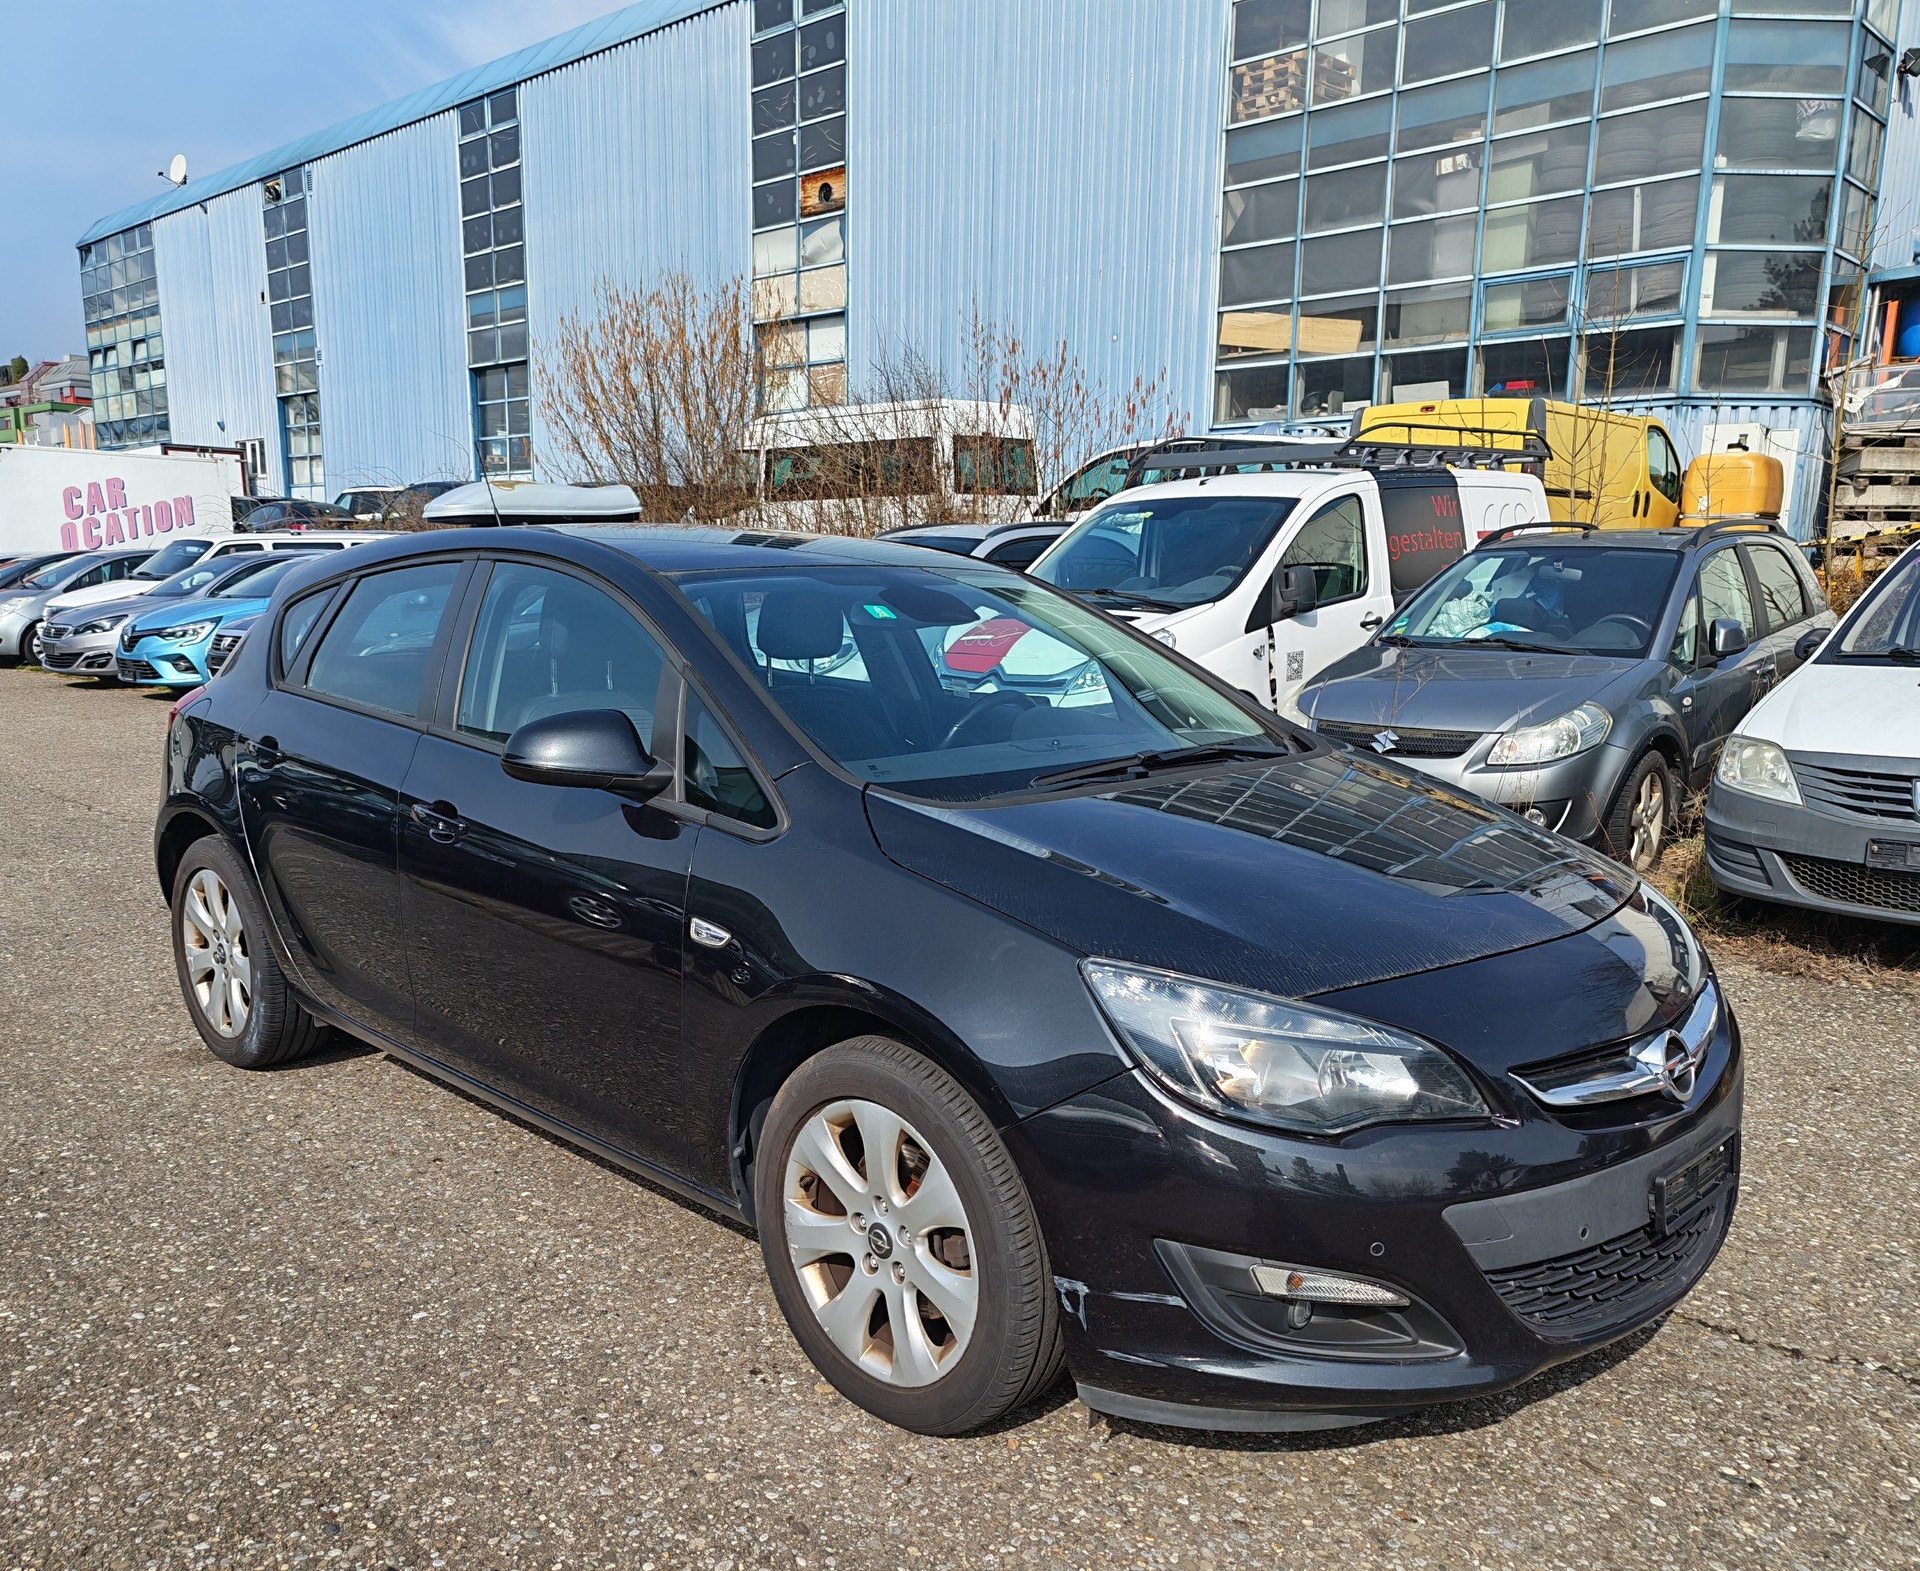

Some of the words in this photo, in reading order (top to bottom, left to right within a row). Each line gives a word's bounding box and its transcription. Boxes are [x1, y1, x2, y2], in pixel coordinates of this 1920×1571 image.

[62, 477, 127, 520] CAR
[1430, 494, 1457, 517] Wir
[60, 494, 195, 552] OCATION
[1389, 524, 1463, 561] gestalten
